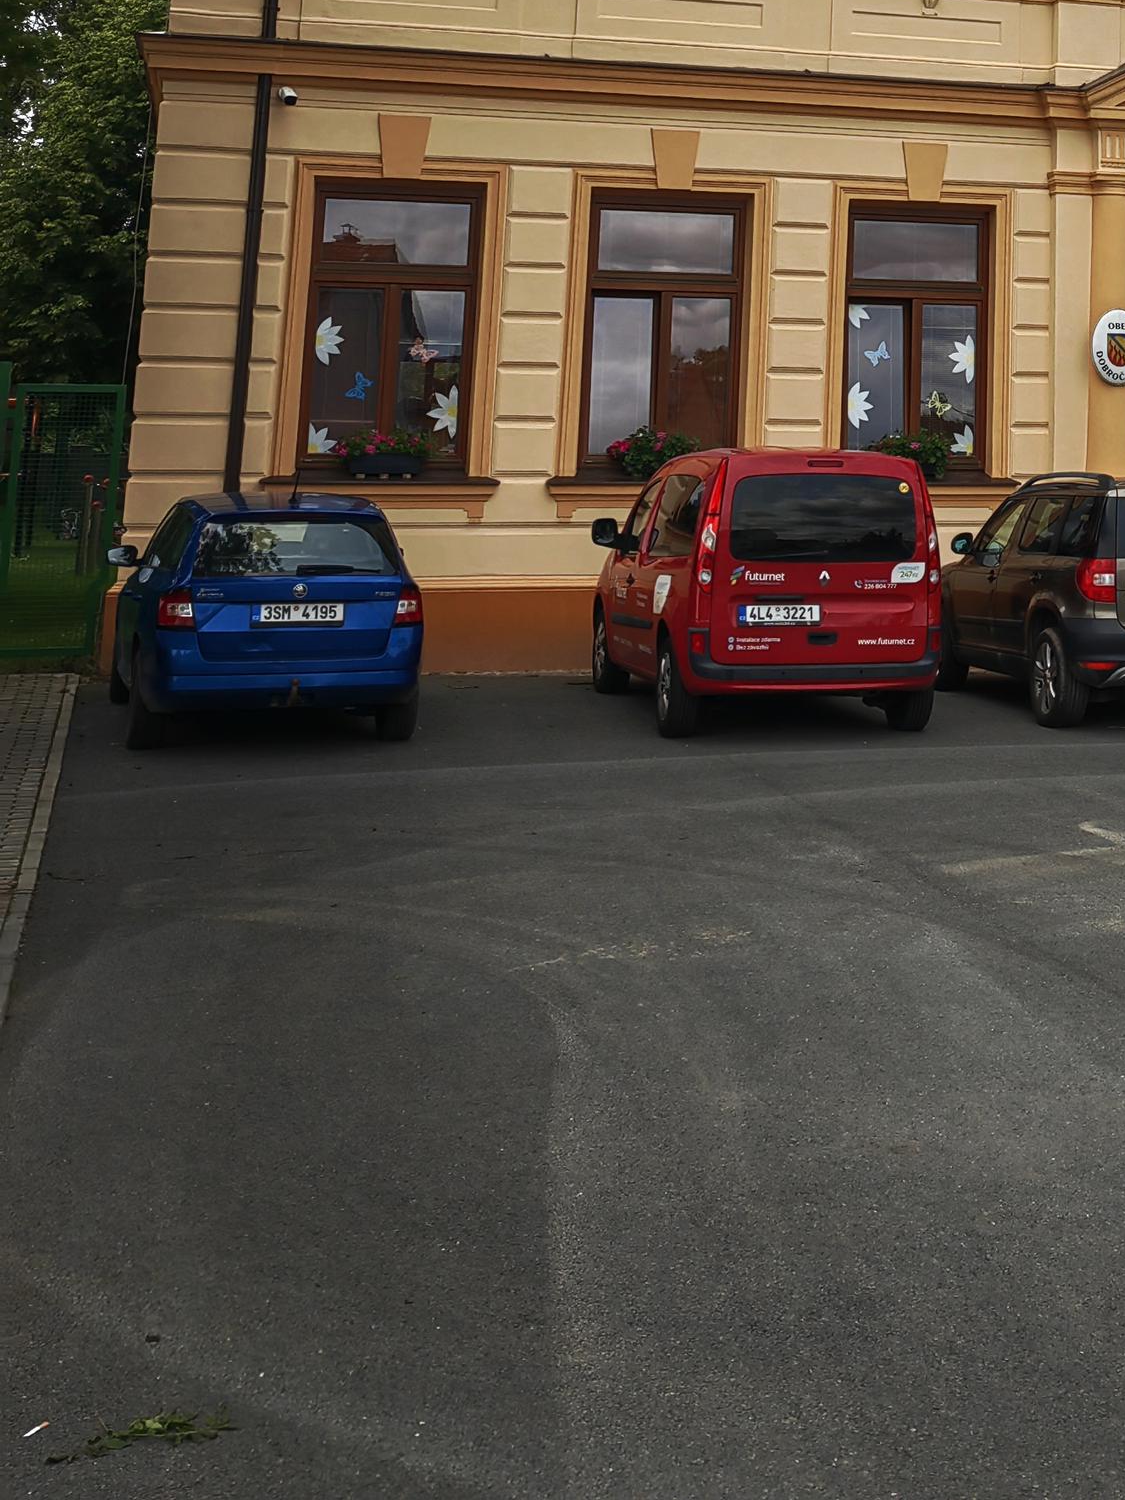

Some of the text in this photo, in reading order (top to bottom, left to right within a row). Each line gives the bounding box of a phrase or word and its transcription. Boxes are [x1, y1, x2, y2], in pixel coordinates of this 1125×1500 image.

[745, 570, 785, 582] futurnet
[264, 605, 337, 620] 3SM 4195
[749, 606, 814, 620] 4L4 3221
[857, 637, 915, 646] www.futurnet.cz
